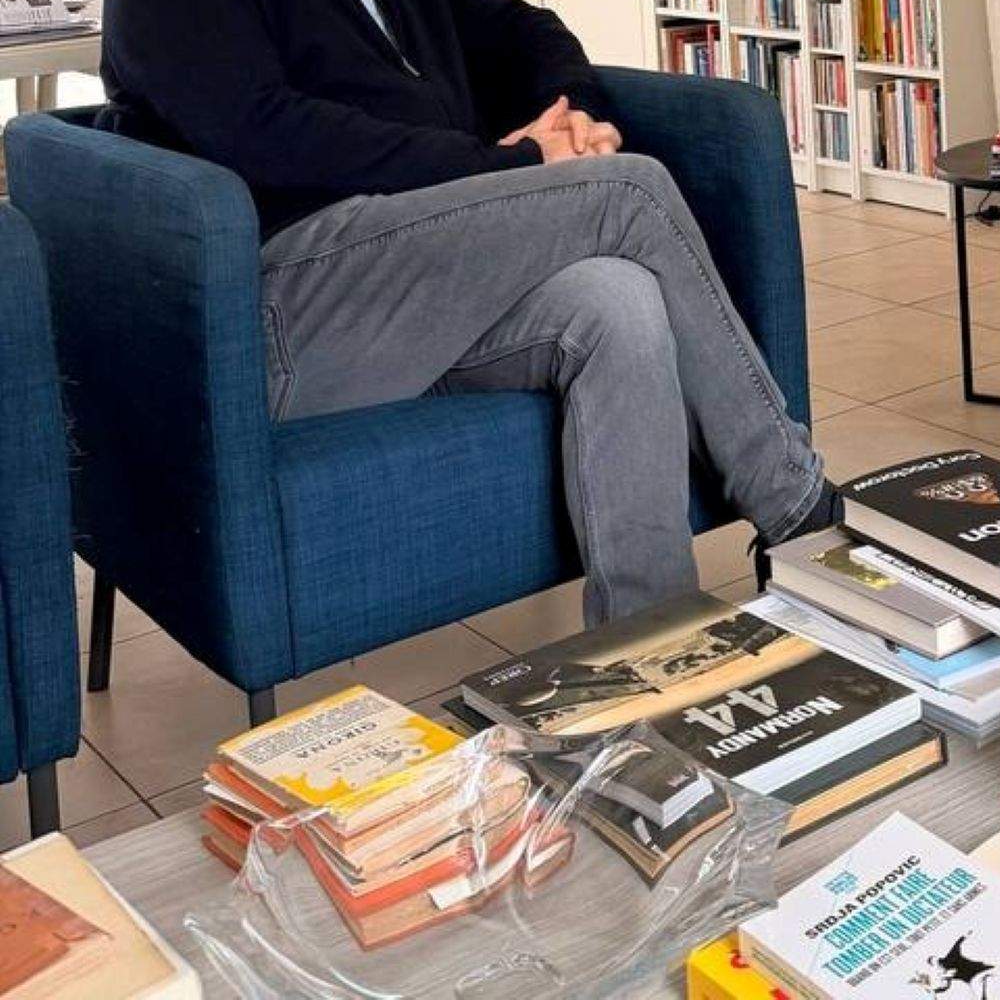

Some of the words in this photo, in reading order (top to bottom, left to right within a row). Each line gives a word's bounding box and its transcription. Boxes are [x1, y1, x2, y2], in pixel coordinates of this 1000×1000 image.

[682, 684, 779, 736] 44
[706, 695, 845, 759] NORMANDY
[804, 902, 858, 940] SRDJA
[855, 854, 922, 904] POPOVIC
[821, 931, 891, 979] TOMBER
[878, 916, 912, 941] UN
[900, 867, 978, 926] DICTATEUR
[823, 894, 900, 950] COMMENT
[890, 868, 937, 903] FAIRE
